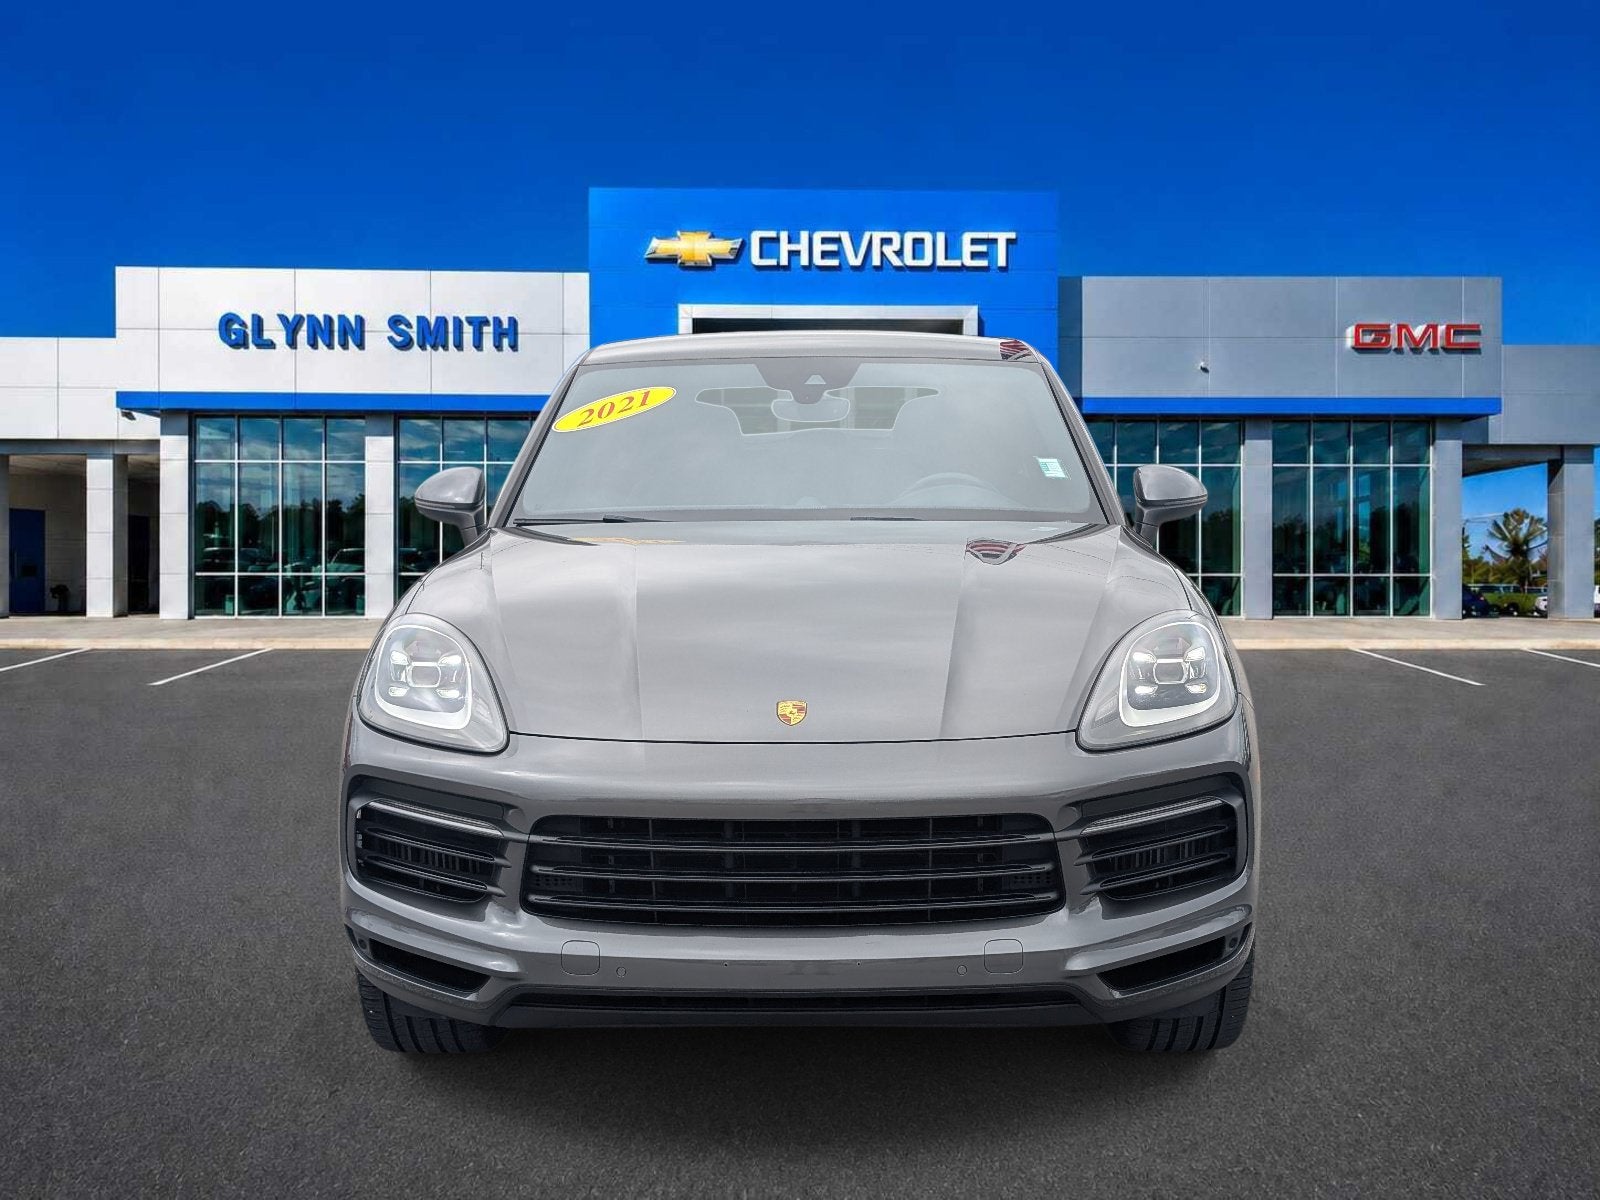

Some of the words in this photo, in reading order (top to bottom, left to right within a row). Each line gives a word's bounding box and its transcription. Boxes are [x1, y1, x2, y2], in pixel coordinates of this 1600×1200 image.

[750, 230, 1017, 268] CHEVROLET
[218, 312, 365, 350] GLYNN
[387, 314, 518, 351] SMITH
[1349, 322, 1482, 350] GMC
[577, 390, 651, 427] 2021
